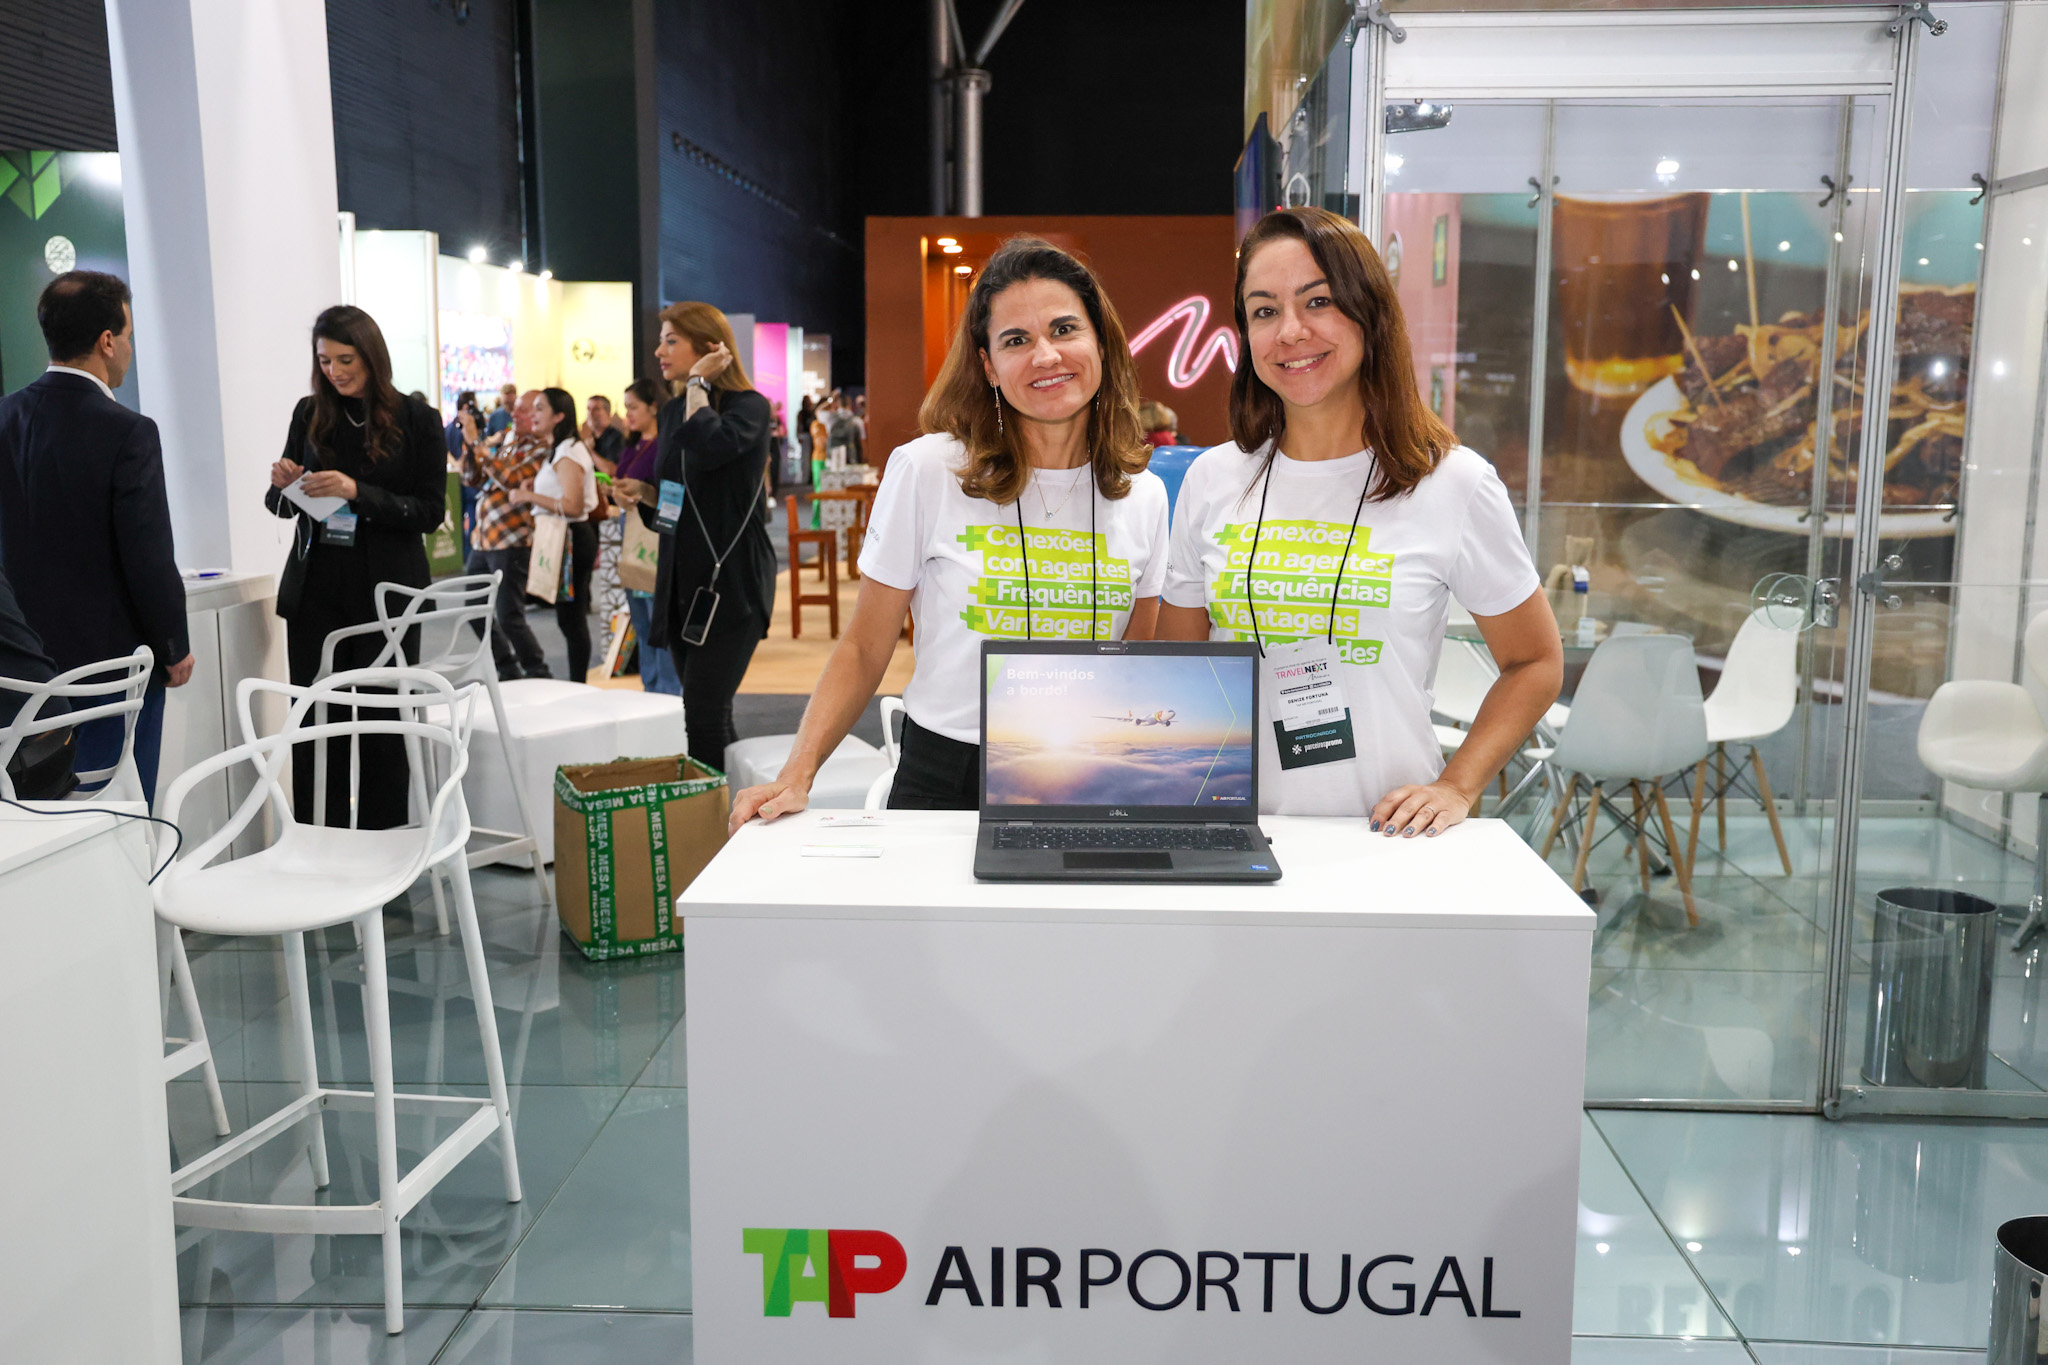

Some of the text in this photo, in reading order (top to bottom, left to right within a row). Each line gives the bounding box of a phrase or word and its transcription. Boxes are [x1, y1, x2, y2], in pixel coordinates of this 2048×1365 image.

[986, 526, 1097, 552] Conexões
[1239, 523, 1357, 547] Conexões
[987, 556, 1128, 580] com agentes
[1230, 551, 1390, 573] com agentes
[998, 581, 1131, 608] Frequências
[1230, 574, 1388, 603] Frequências
[985, 609, 1110, 638] Vantagens
[1221, 604, 1356, 634] Vantagens
[1007, 669, 1095, 680] Bem-vindos
[1006, 684, 1068, 696] a bordo!
[650, 811, 663, 850] MESA
[598, 854, 610, 892] MESA
[654, 855, 667, 893] MESA
[657, 896, 669, 934] MESA
[640, 939, 677, 953] MESA
[743, 1227, 908, 1318] TAP
